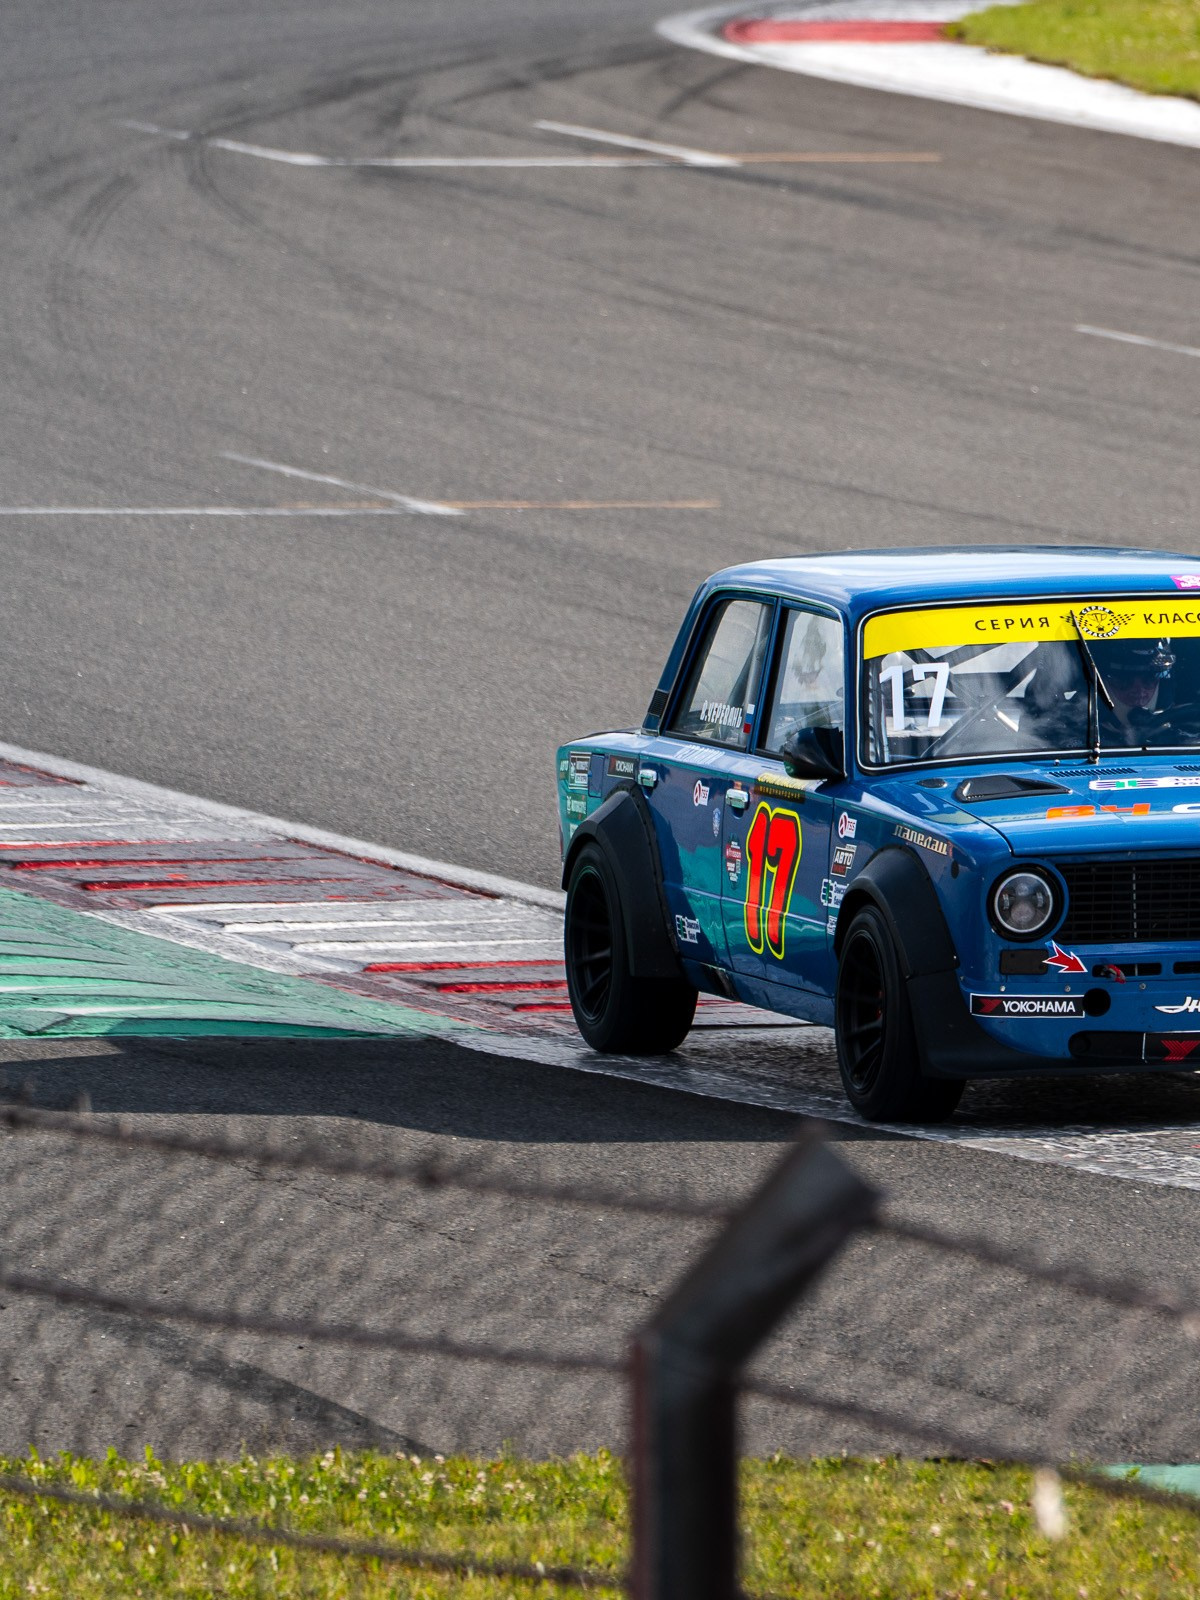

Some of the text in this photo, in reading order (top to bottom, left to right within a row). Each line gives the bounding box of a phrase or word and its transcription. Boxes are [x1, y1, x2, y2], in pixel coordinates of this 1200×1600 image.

[975, 616, 1050, 631] СЕРИЯ
[879, 662, 950, 731] 17
[744, 801, 803, 960] 17
[1002, 1000, 1077, 1013] YOKOHAMA
